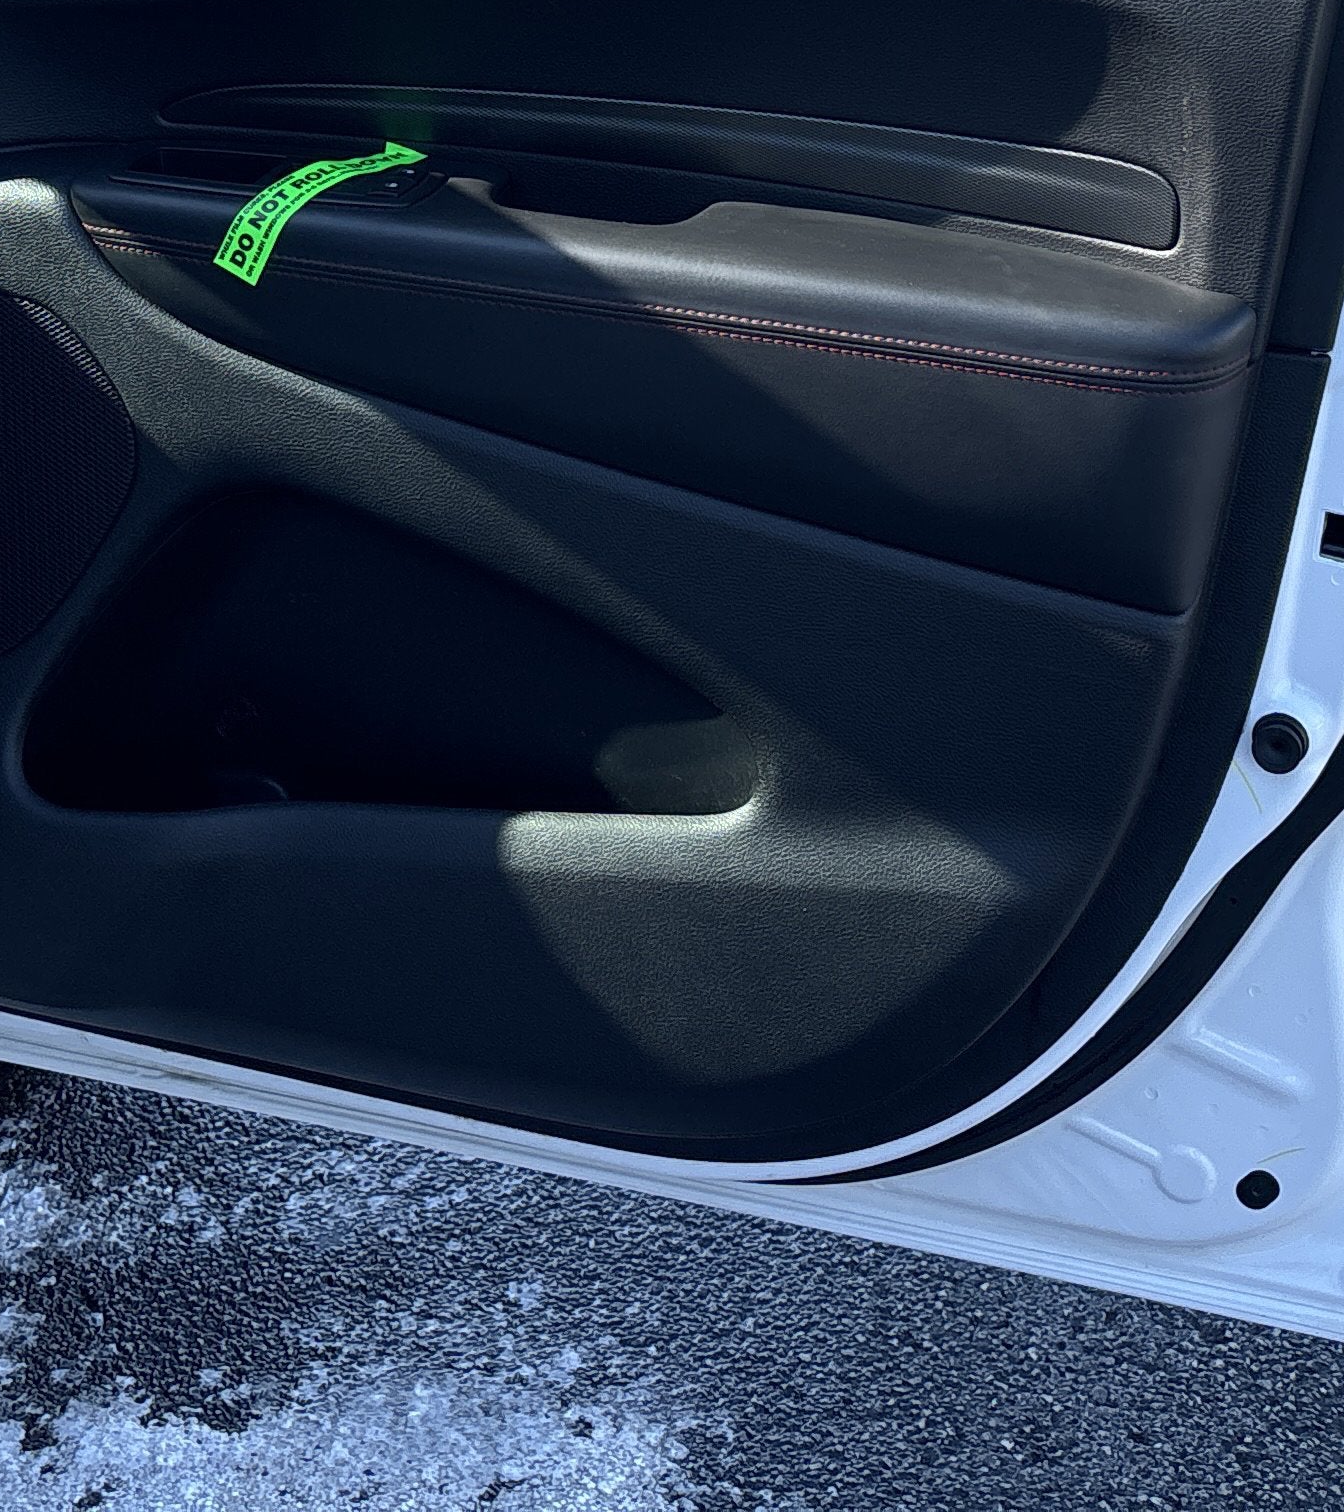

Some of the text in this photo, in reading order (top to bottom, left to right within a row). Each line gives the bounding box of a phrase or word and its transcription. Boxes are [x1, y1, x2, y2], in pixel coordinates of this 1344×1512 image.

[229, 233, 255, 269] DO
[247, 188, 290, 231] NOT
[289, 163, 347, 190] ROLL
